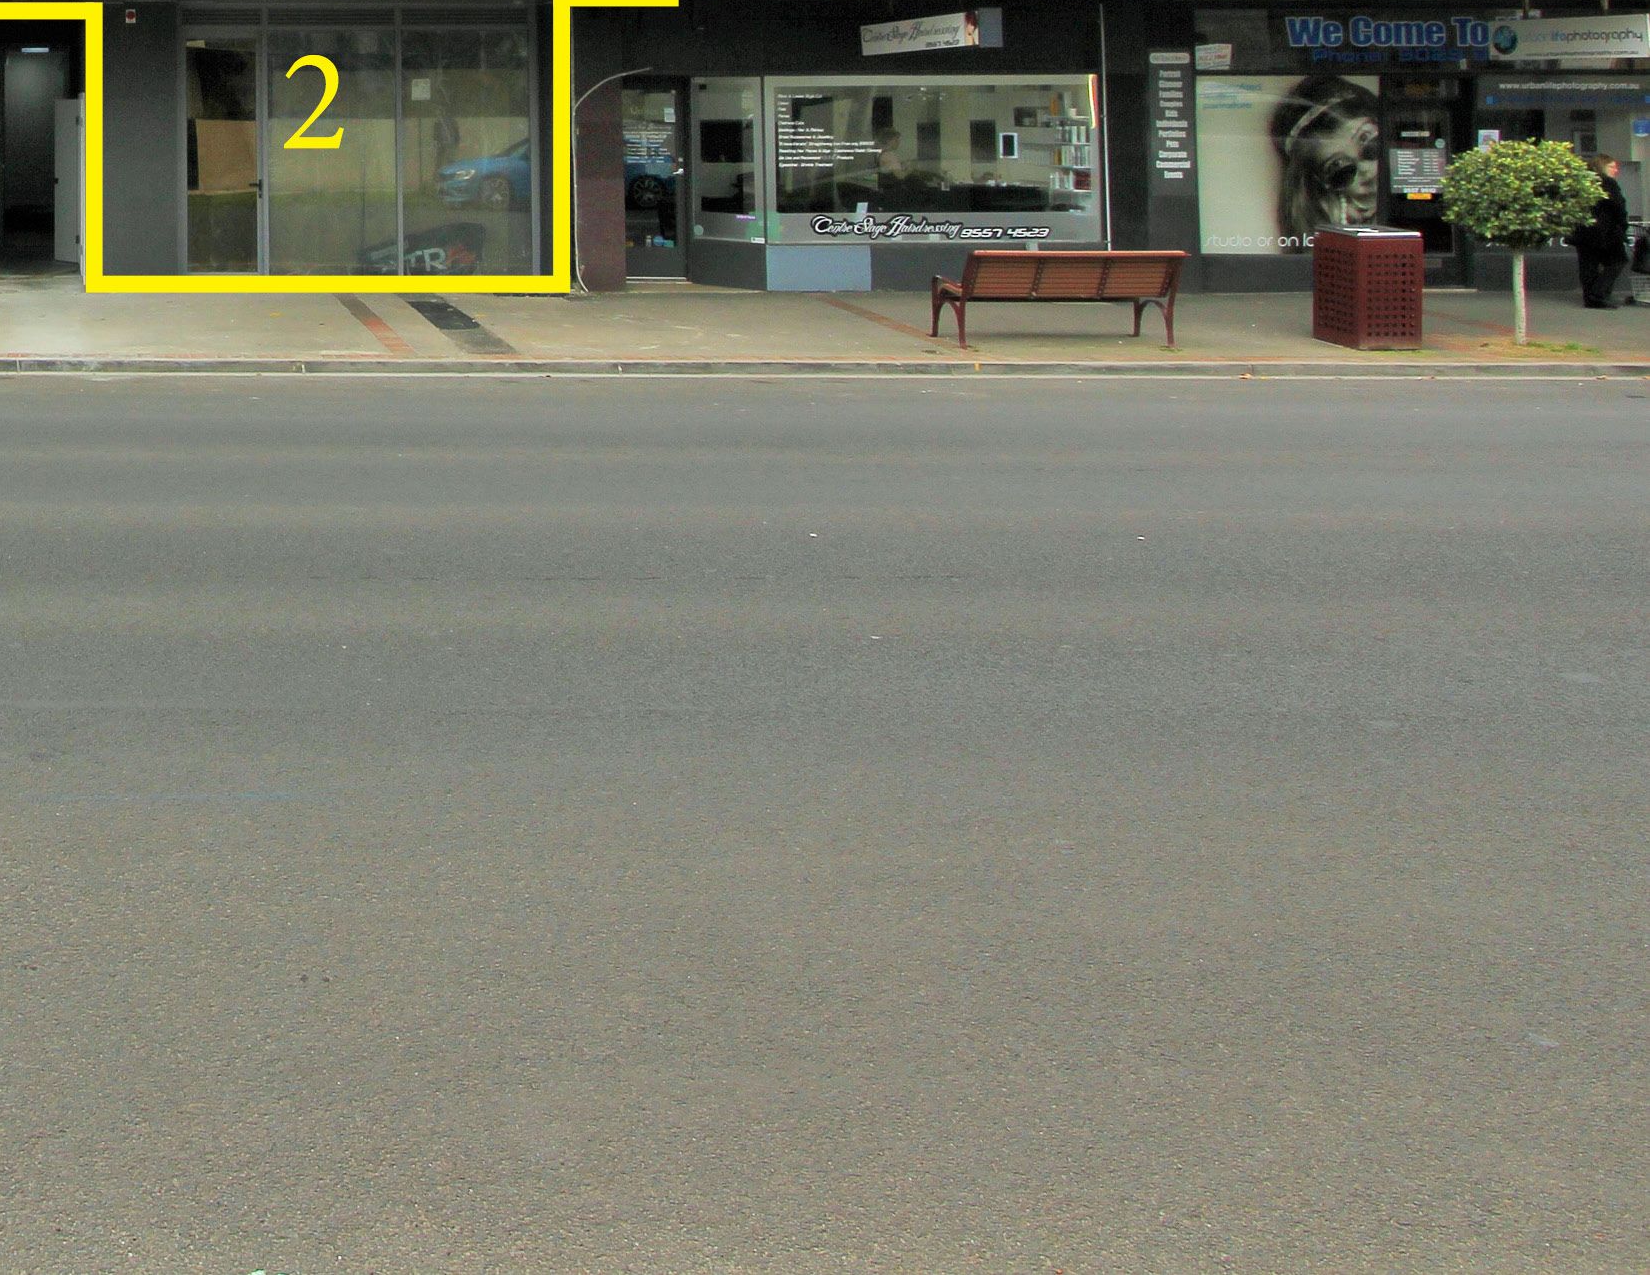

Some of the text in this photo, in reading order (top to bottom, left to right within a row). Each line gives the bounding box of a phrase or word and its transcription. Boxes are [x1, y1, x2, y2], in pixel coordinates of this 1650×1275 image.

[1285, 15, 1491, 47] We Come To
[813, 215, 1050, 239] Centre Stage Hairdressing 9557 4523
[1278, 236, 1299, 247] on
